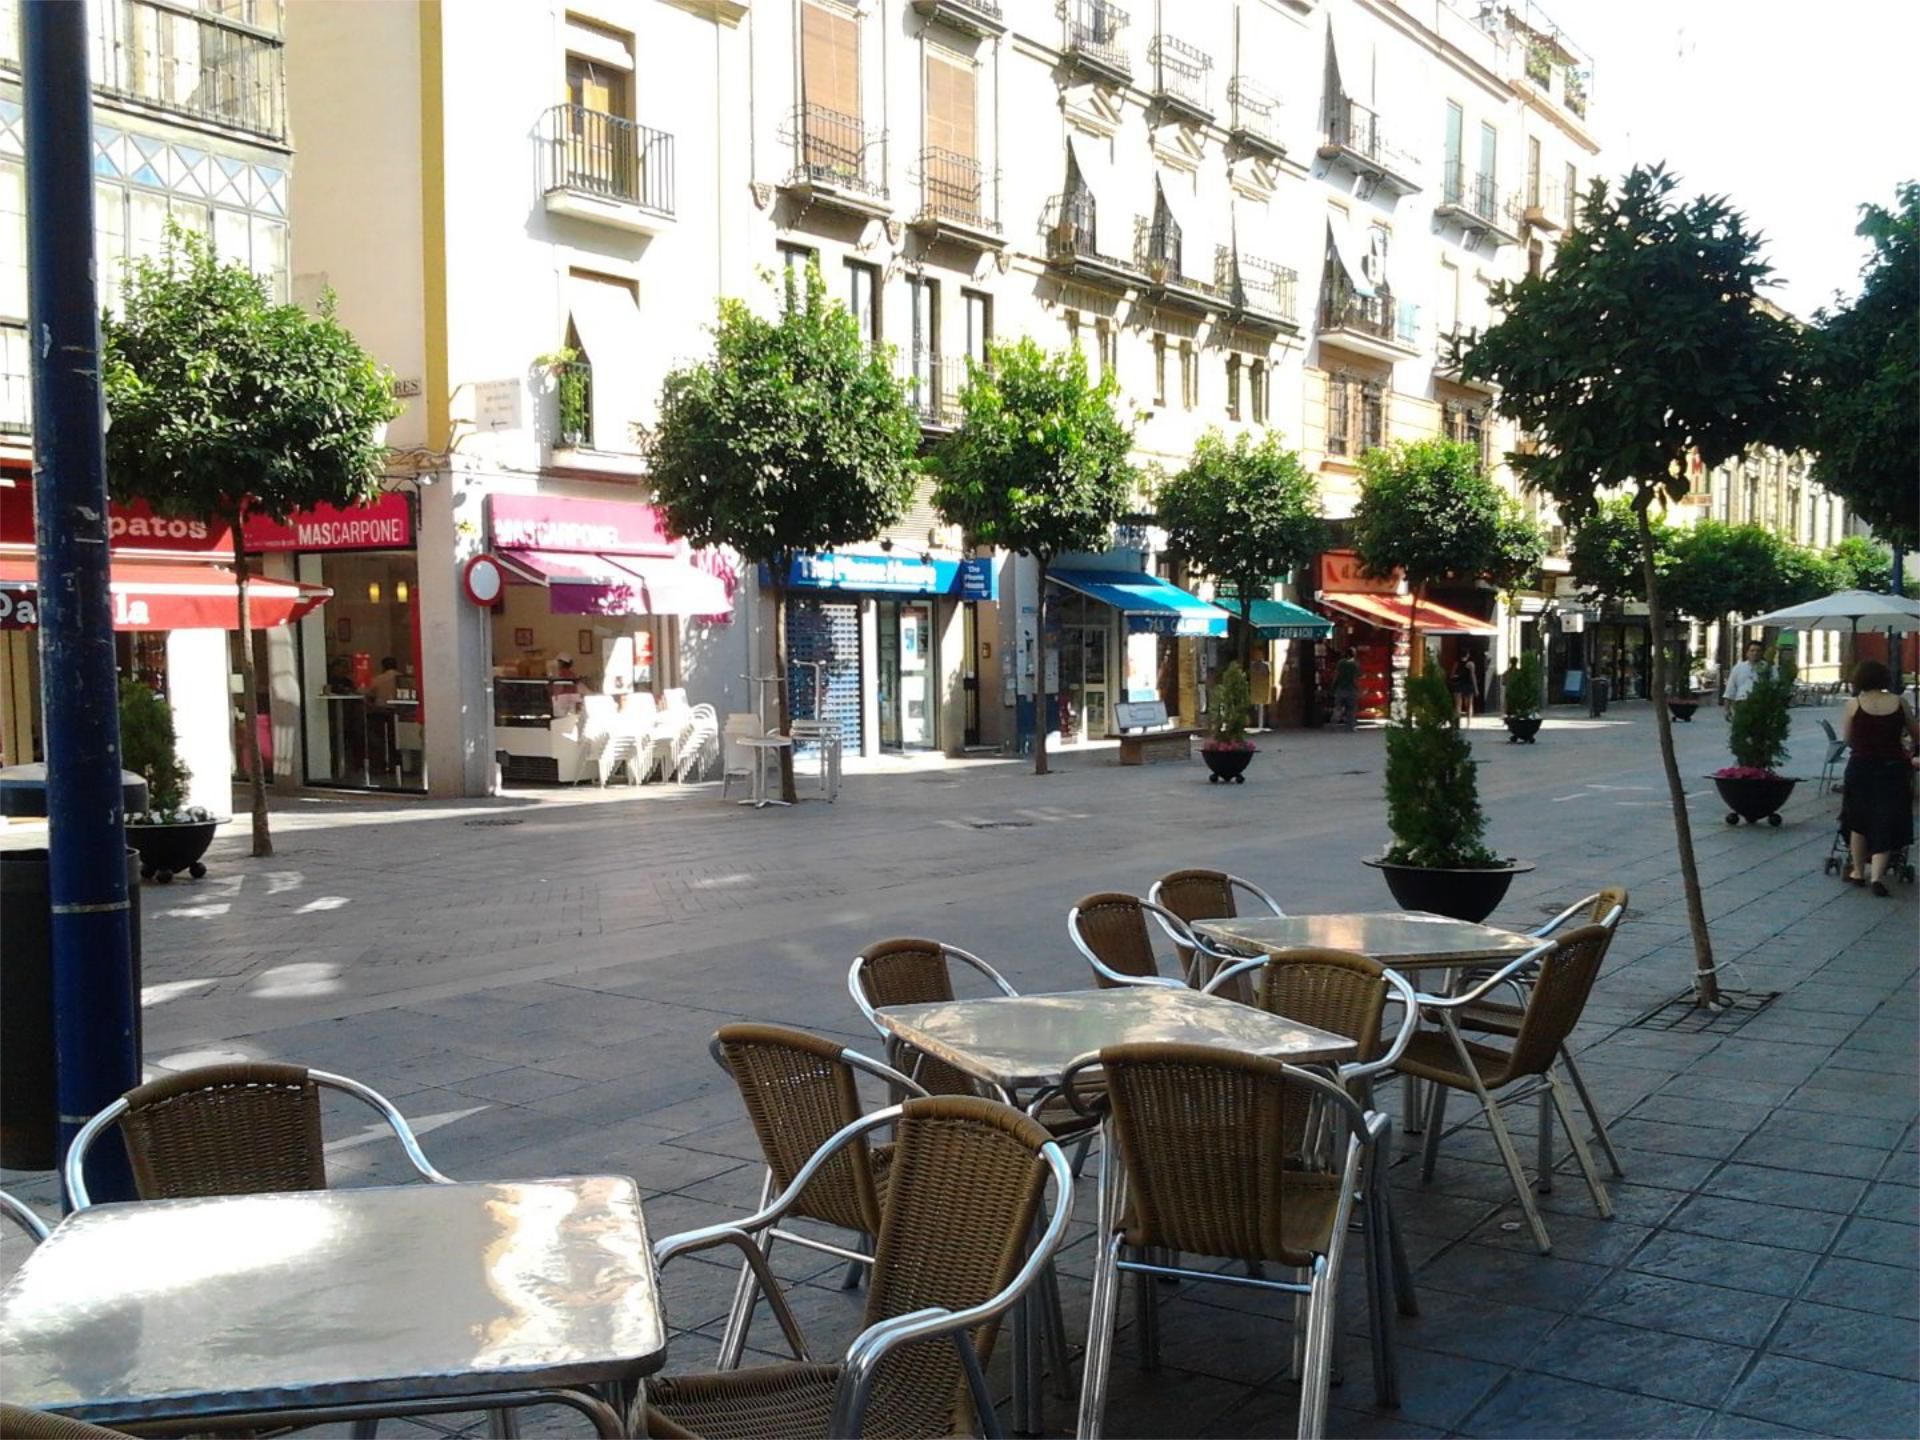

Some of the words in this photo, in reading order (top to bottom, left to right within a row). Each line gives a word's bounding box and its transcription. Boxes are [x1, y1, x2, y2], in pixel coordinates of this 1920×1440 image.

[394, 380, 418, 394] RES
[110, 516, 208, 539] patos
[299, 519, 402, 546] MASCARPONE
[114, 592, 150, 625] la
